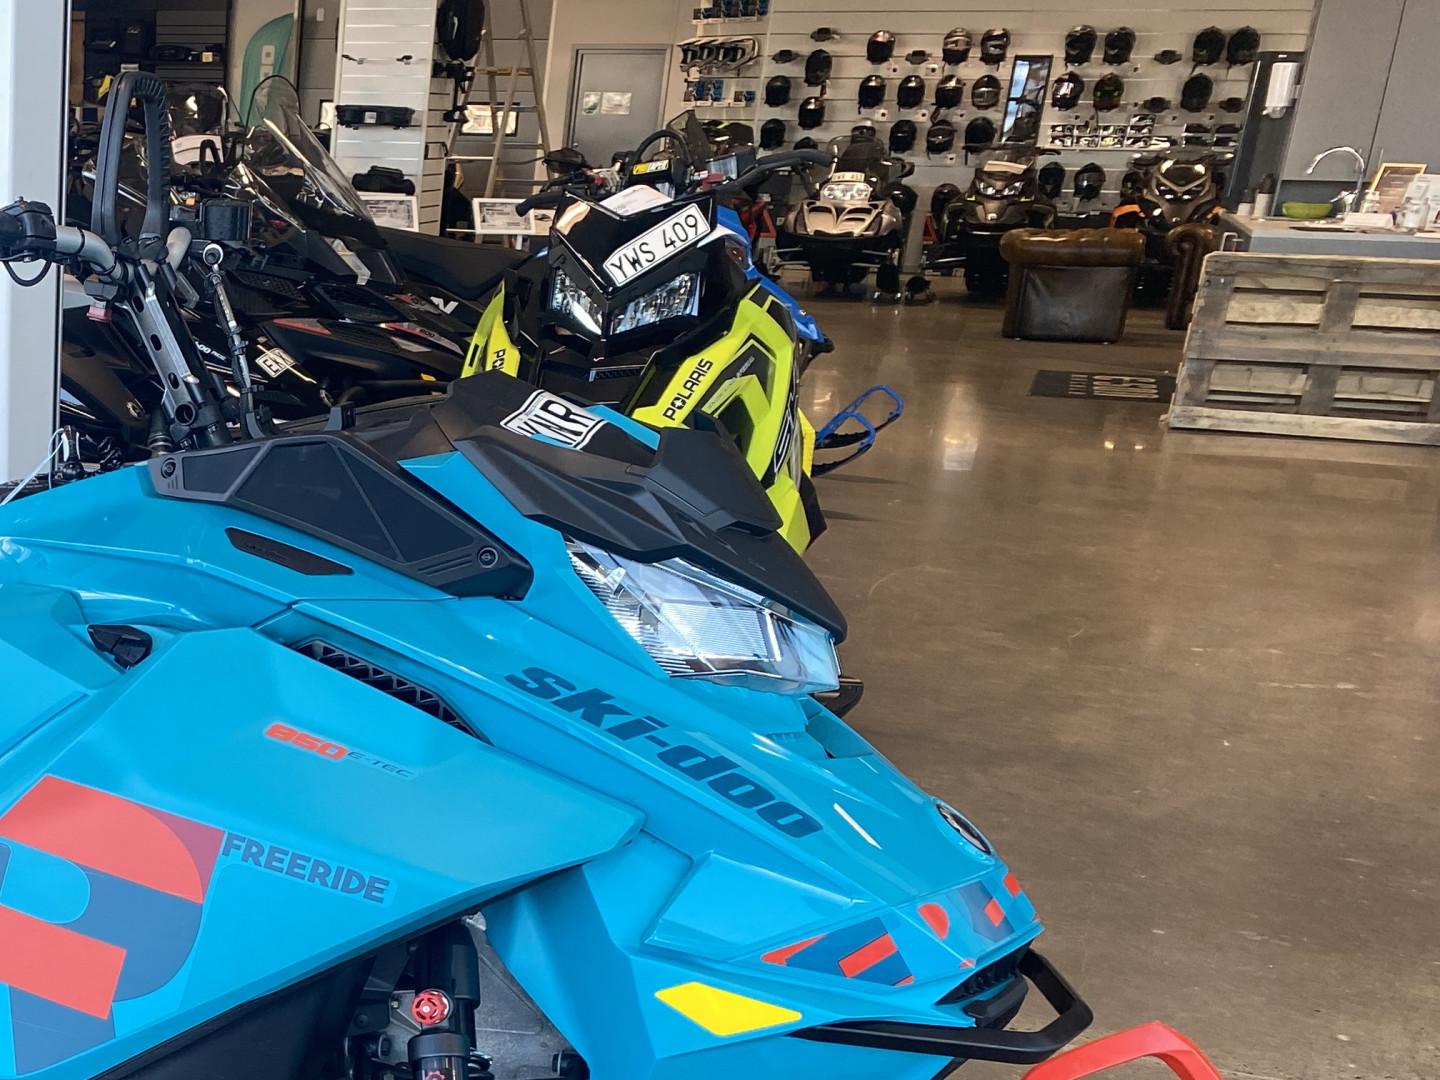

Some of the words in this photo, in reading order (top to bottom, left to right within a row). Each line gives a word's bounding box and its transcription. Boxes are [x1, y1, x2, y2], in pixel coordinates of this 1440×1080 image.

[609, 241, 657, 279] YWS
[661, 214, 699, 249] 409
[662, 357, 714, 421] POLARIS
[264, 722, 349, 761] 850
[348, 751, 414, 778] E-TEC
[221, 831, 391, 905] FREERIDE
